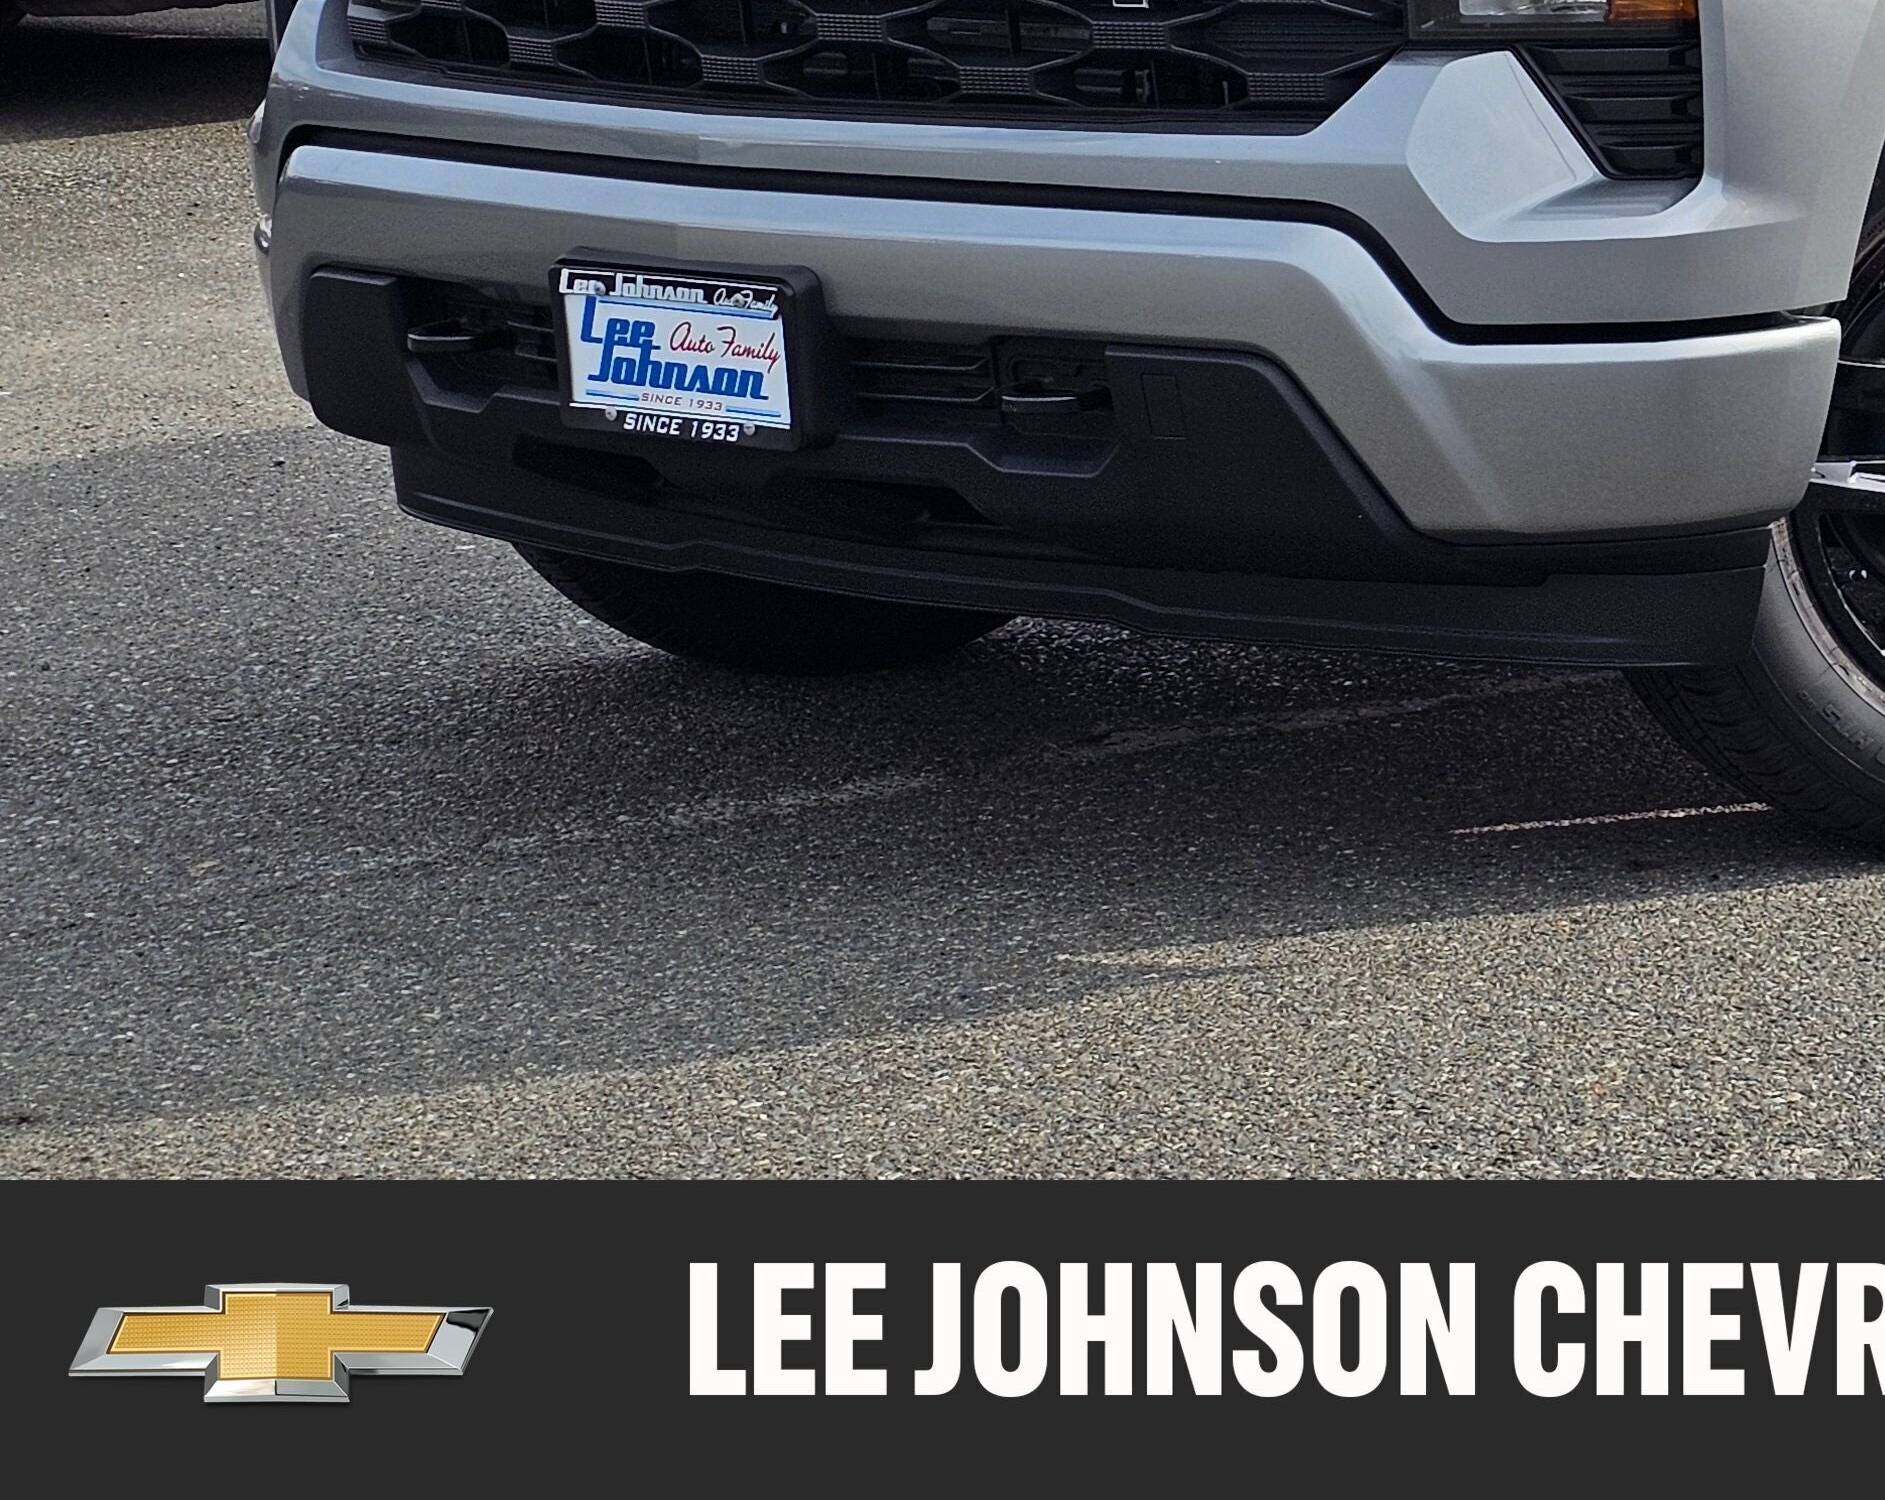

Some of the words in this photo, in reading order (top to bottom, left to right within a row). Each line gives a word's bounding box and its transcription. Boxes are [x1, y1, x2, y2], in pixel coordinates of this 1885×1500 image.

[609, 273, 708, 303] Johnson
[740, 290, 778, 319] Family
[580, 296, 661, 350] Lee
[587, 334, 769, 400] Johnson
[669, 322, 715, 354] Auto
[717, 326, 781, 374] Family
[641, 392, 682, 406] SINCE
[689, 398, 723, 411] 1933
[623, 413, 683, 435] SINCE
[690, 420, 740, 442] 1933
